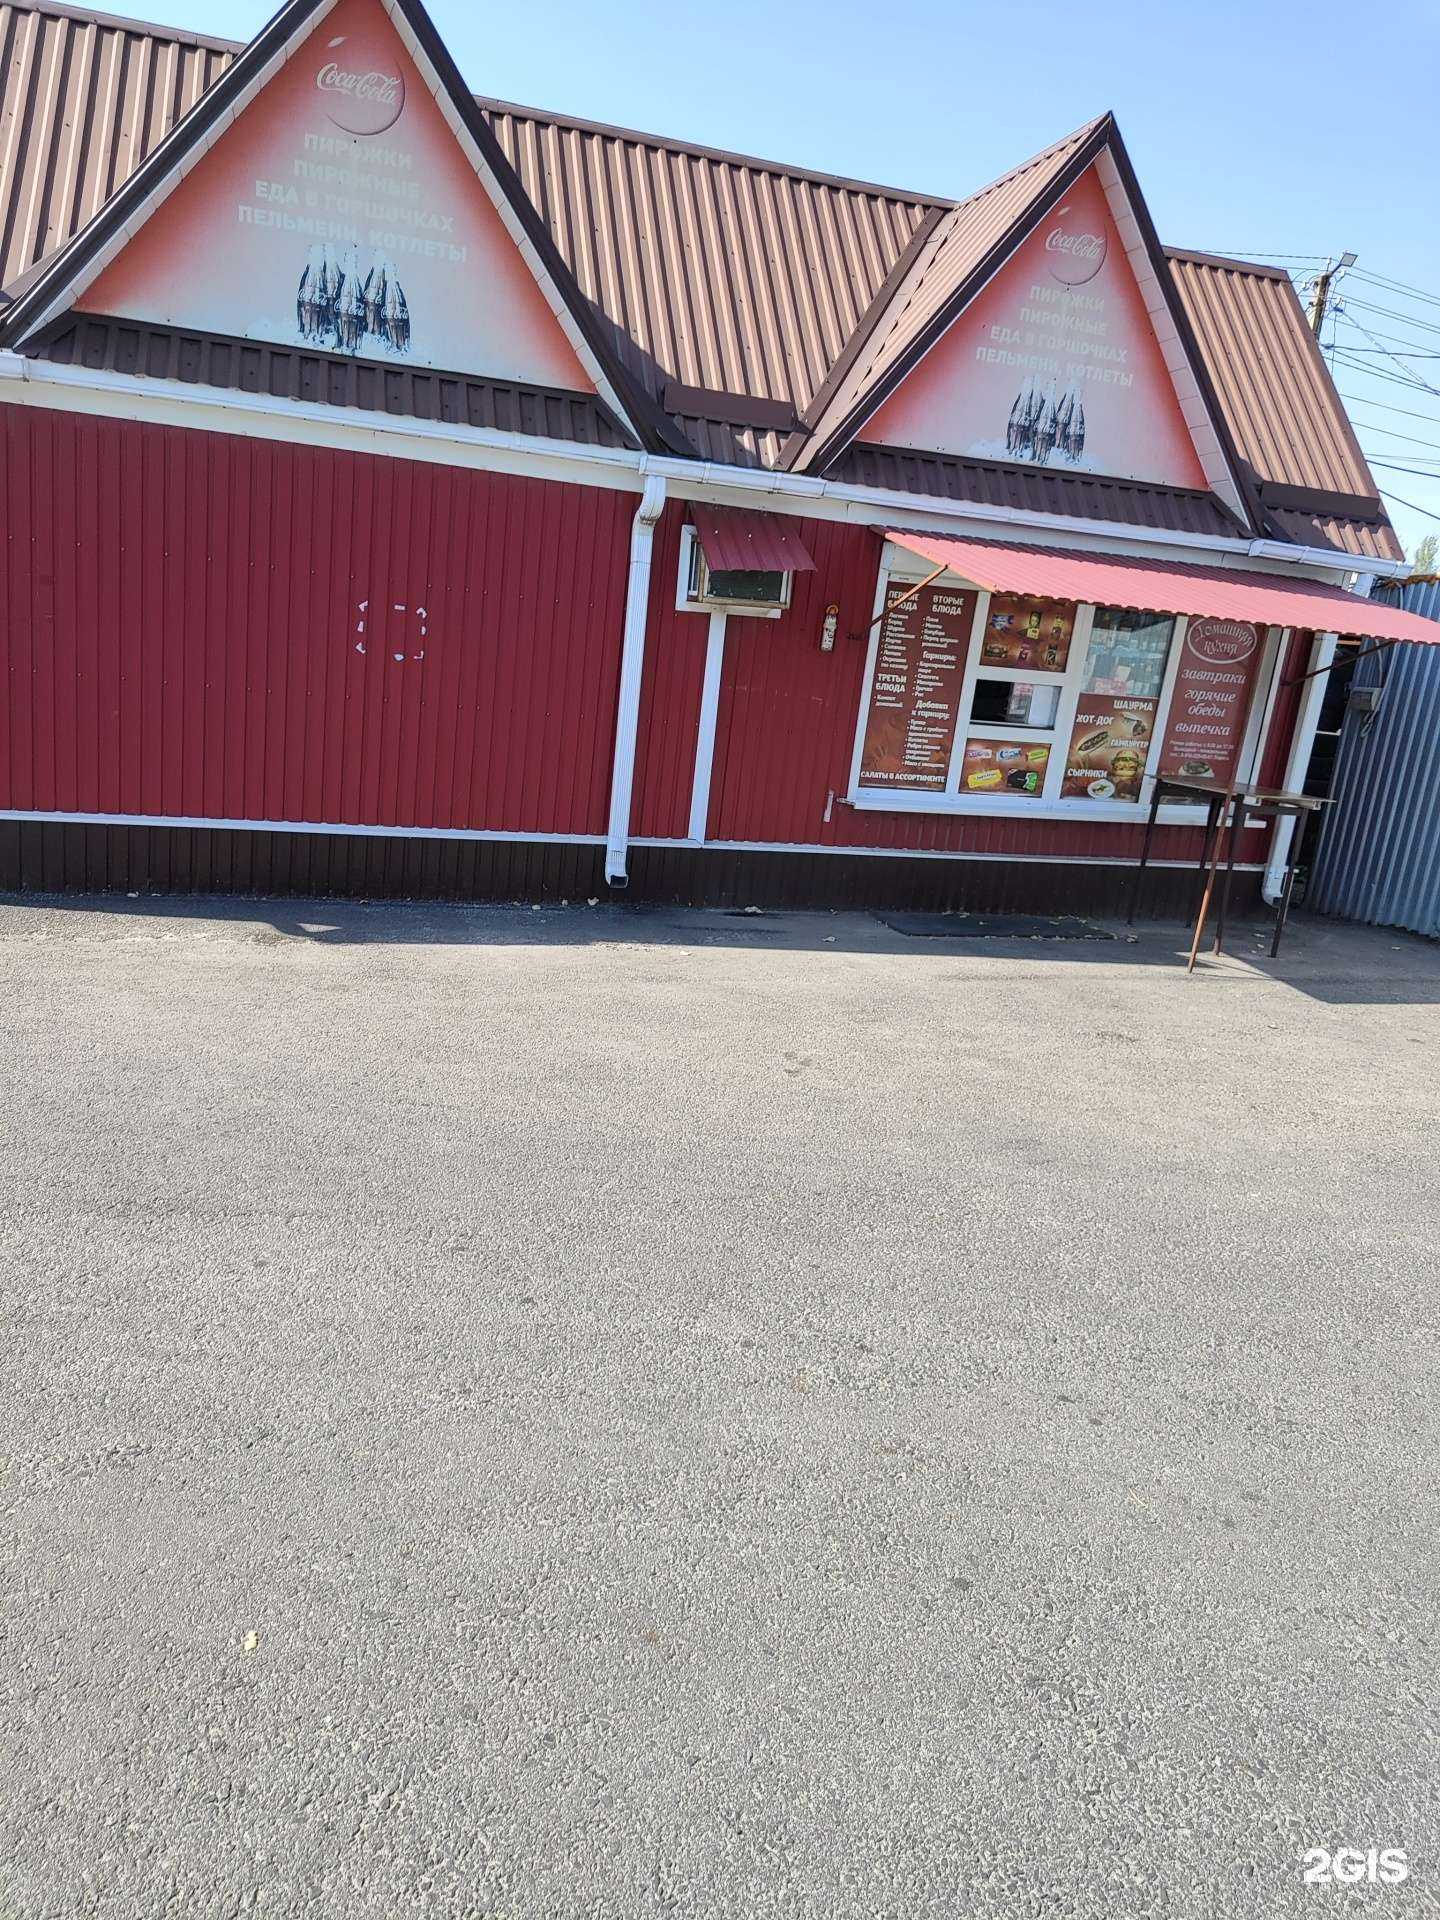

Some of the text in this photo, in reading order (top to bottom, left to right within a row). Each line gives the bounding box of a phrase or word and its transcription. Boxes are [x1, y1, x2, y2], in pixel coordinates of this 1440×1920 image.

[316, 63, 401, 104] Coca-Cola
[304, 134, 412, 170] ПИРОЖКИ
[255, 180, 455, 233] ЕДА В ГОРШОЧКАХ
[368, 230, 468, 264] КОТЛЕТЫ
[1045, 228, 1105, 257] Coca-Cola
[1030, 285, 1105, 313] ПИРОЖКИ
[1020, 308, 1108, 337] ПИРОЖНЫЕ
[990, 325, 1129, 363] ЕДА В ГОРШОЧКАХ
[1066, 362, 1134, 387] КОТЛЕТЫ
[933, 594, 964, 606] ВТОРЫЕ
[932, 604, 962, 616] БЛЮДА
[878, 673, 907, 684] ТРЕТЬИ
[1181, 667, 1247, 686] завтраки
[876, 682, 906, 694] БЛЮДА
[1184, 688, 1237, 704] горячие
[1113, 699, 1153, 712] ШАУРМА
[1187, 703, 1226, 718] обеды
[1076, 714, 1115, 726] ХОТ-ДОГ
[1175, 721, 1231, 737] выпечка
[860, 771, 889, 781] САЛАТЫ
[895, 774, 946, 784] АССОРТИМЕНТЕ
[1067, 768, 1108, 779] СЫРНИКИ
